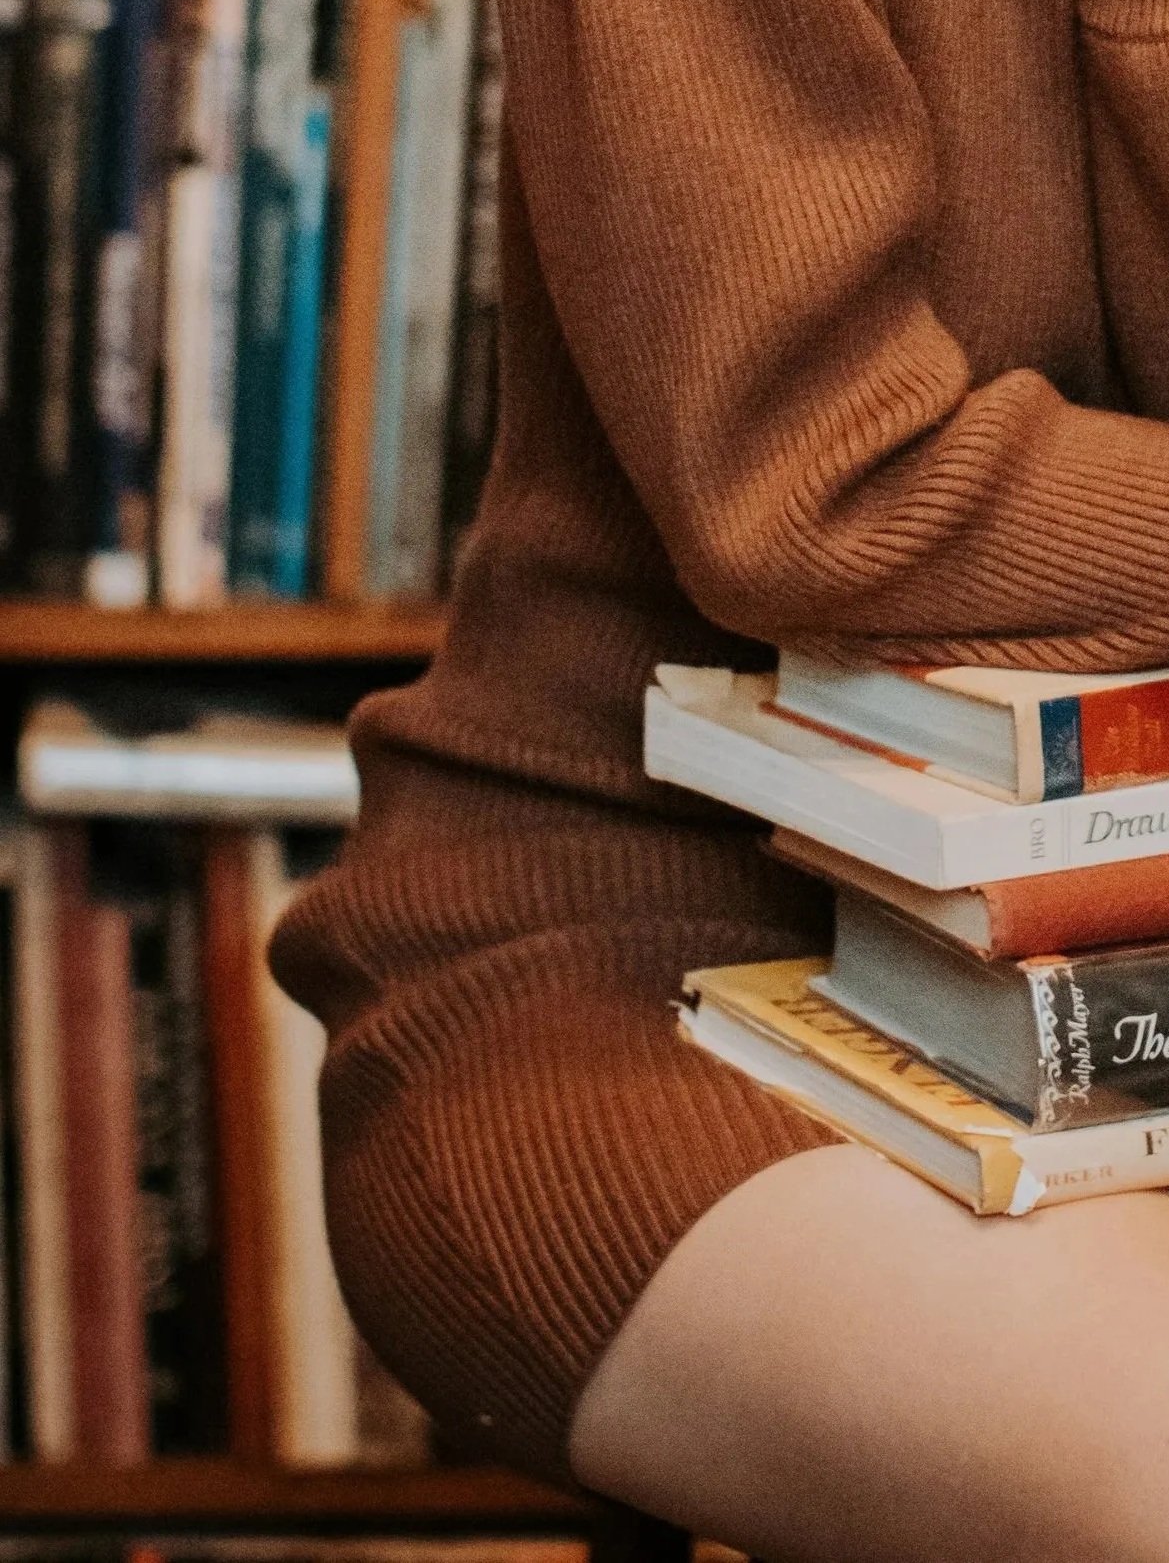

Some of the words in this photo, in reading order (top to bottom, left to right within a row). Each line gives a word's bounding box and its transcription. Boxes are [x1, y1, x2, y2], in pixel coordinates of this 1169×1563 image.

[1029, 818, 1046, 860] BRO
[1066, 983, 1091, 1049] Mayer
[1068, 1047, 1096, 1105] Ralph
